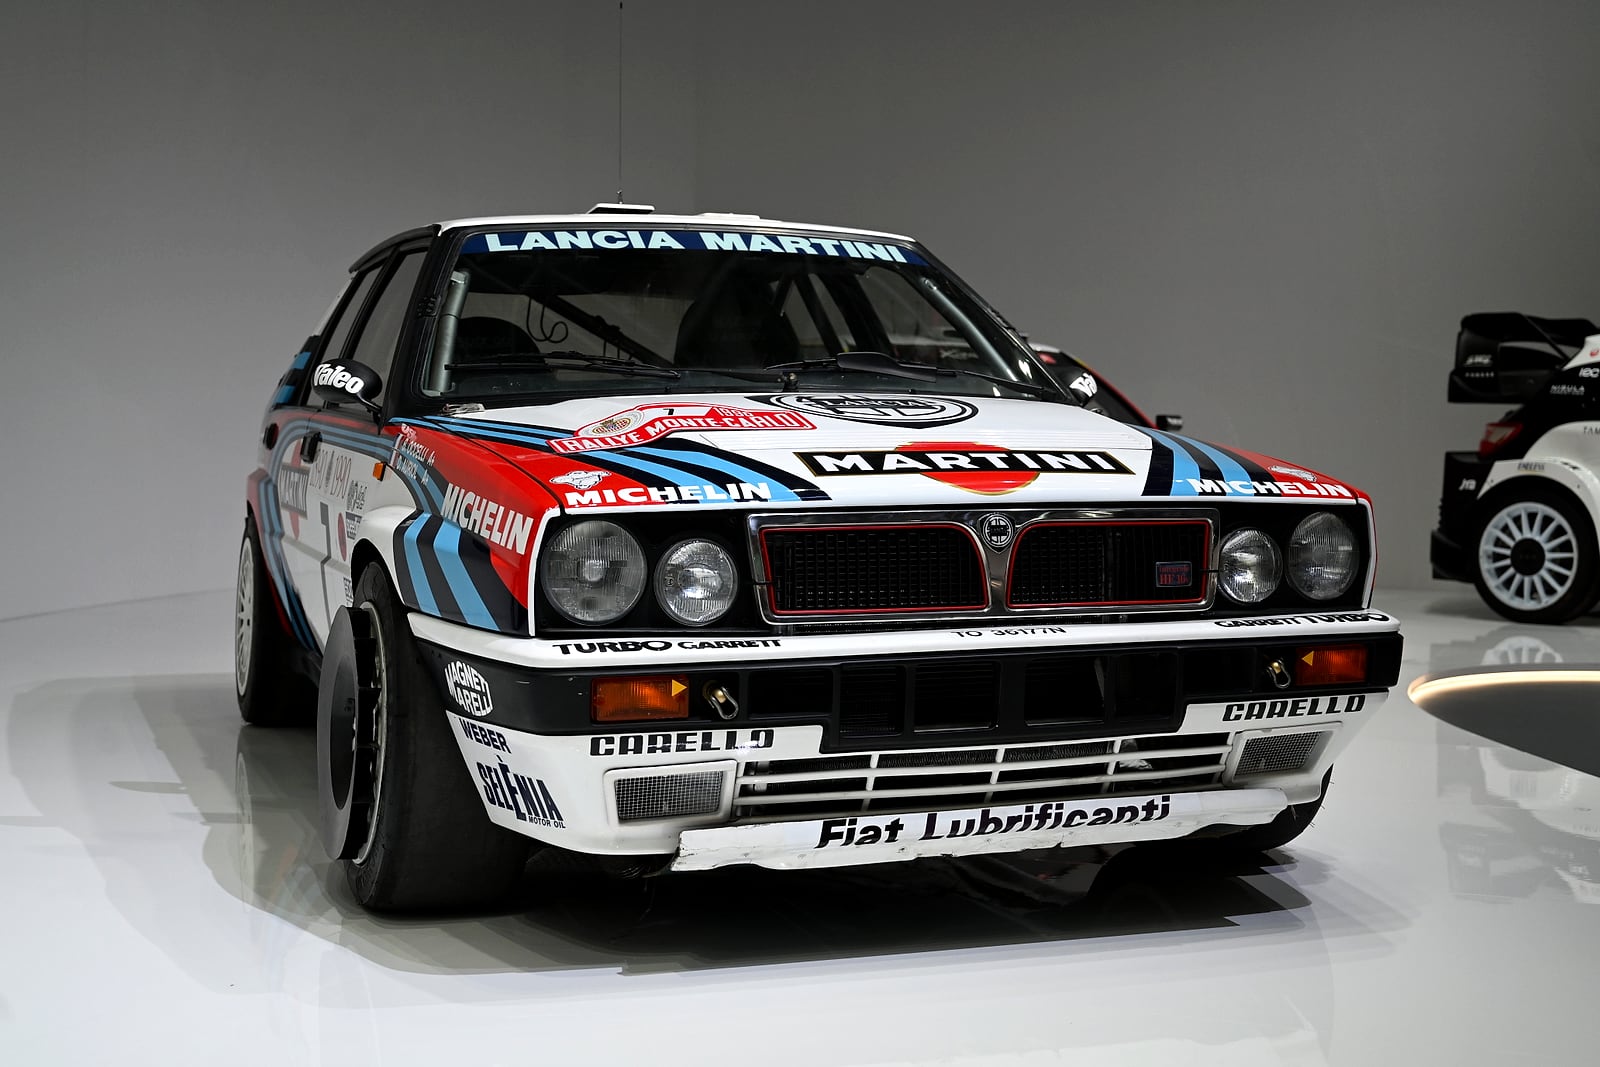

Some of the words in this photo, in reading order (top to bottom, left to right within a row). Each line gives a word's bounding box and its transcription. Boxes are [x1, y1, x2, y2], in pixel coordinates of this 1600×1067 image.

[484, 231, 685, 252] LANCIA
[699, 232, 907, 263] MARTINI
[662, 408, 675, 417] 7
[562, 431, 644, 451] RALLYE
[648, 412, 797, 437] MONTE-CARLO
[810, 452, 1116, 473] MARTINI
[565, 482, 772, 506] MICHELIN
[1185, 477, 1352, 497] MICHELIN
[441, 482, 534, 555] MICHELIN
[1214, 616, 1300, 628] GARRETT
[1298, 612, 1390, 624] TURBO
[951, 630, 983, 638] TO
[552, 640, 673, 655] TURBO
[677, 639, 782, 650] GARRETT
[1222, 694, 1366, 722] CARELLO
[459, 718, 512, 754] WEBER
[589, 729, 775, 756] CARELLO
[528, 815, 551, 827] MOTOR
[553, 820, 566, 829] OIL
[814, 816, 905, 849] Fiat
[918, 795, 1171, 841] Lubrificanti
